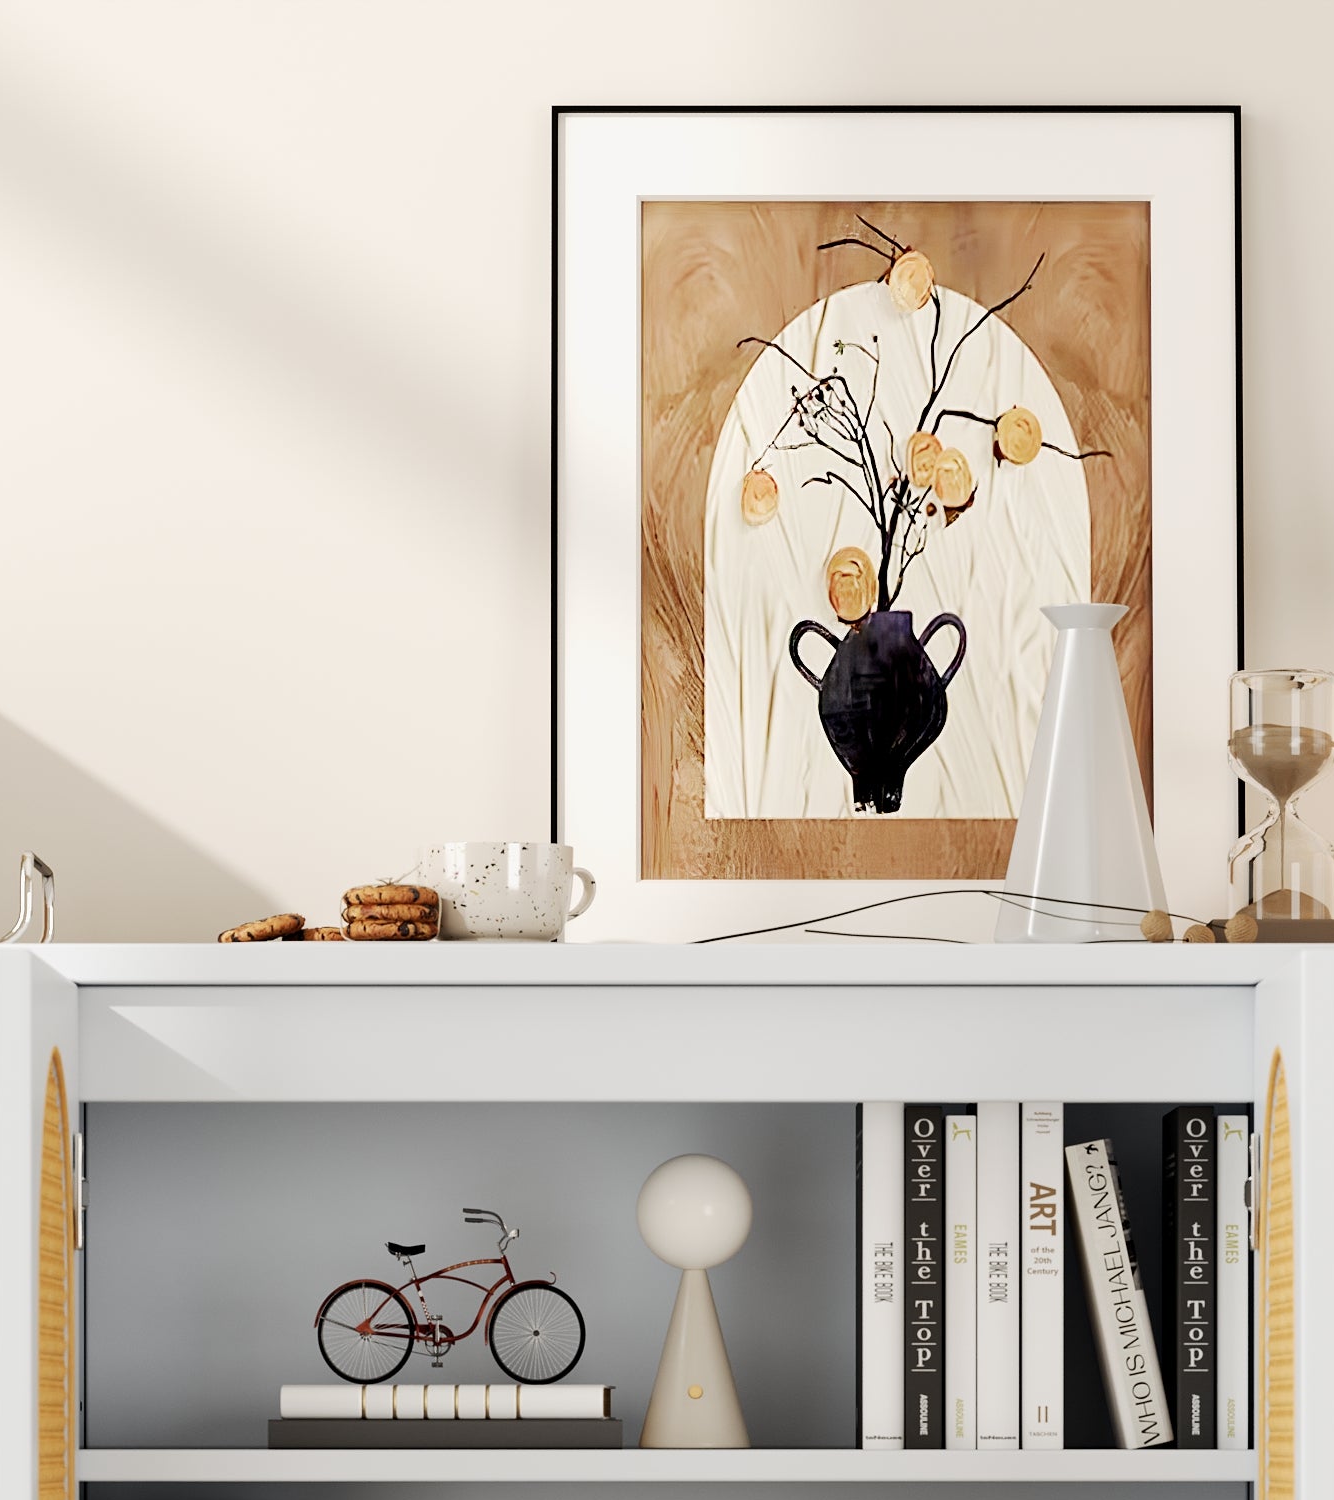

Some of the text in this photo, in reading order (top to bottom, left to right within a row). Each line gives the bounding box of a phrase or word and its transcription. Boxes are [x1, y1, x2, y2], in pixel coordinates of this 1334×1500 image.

[1030, 1182, 1056, 1236] ART
[874, 1241, 894, 1302] THE BIKE BOOK
[912, 1119, 936, 1372] Over the Top
[953, 1224, 968, 1265] EAMES
[988, 1241, 1009, 1302] THE BIKE BOOK
[1184, 1119, 1208, 1372] Over the Top
[1224, 1223, 1240, 1265] EAMES
[1085, 1165, 1161, 1445] WHO IS MICHAEL JANG?
[919, 1393, 929, 1436] ASSOULINE
[1191, 1393, 1201, 1436] ASSOULINE
